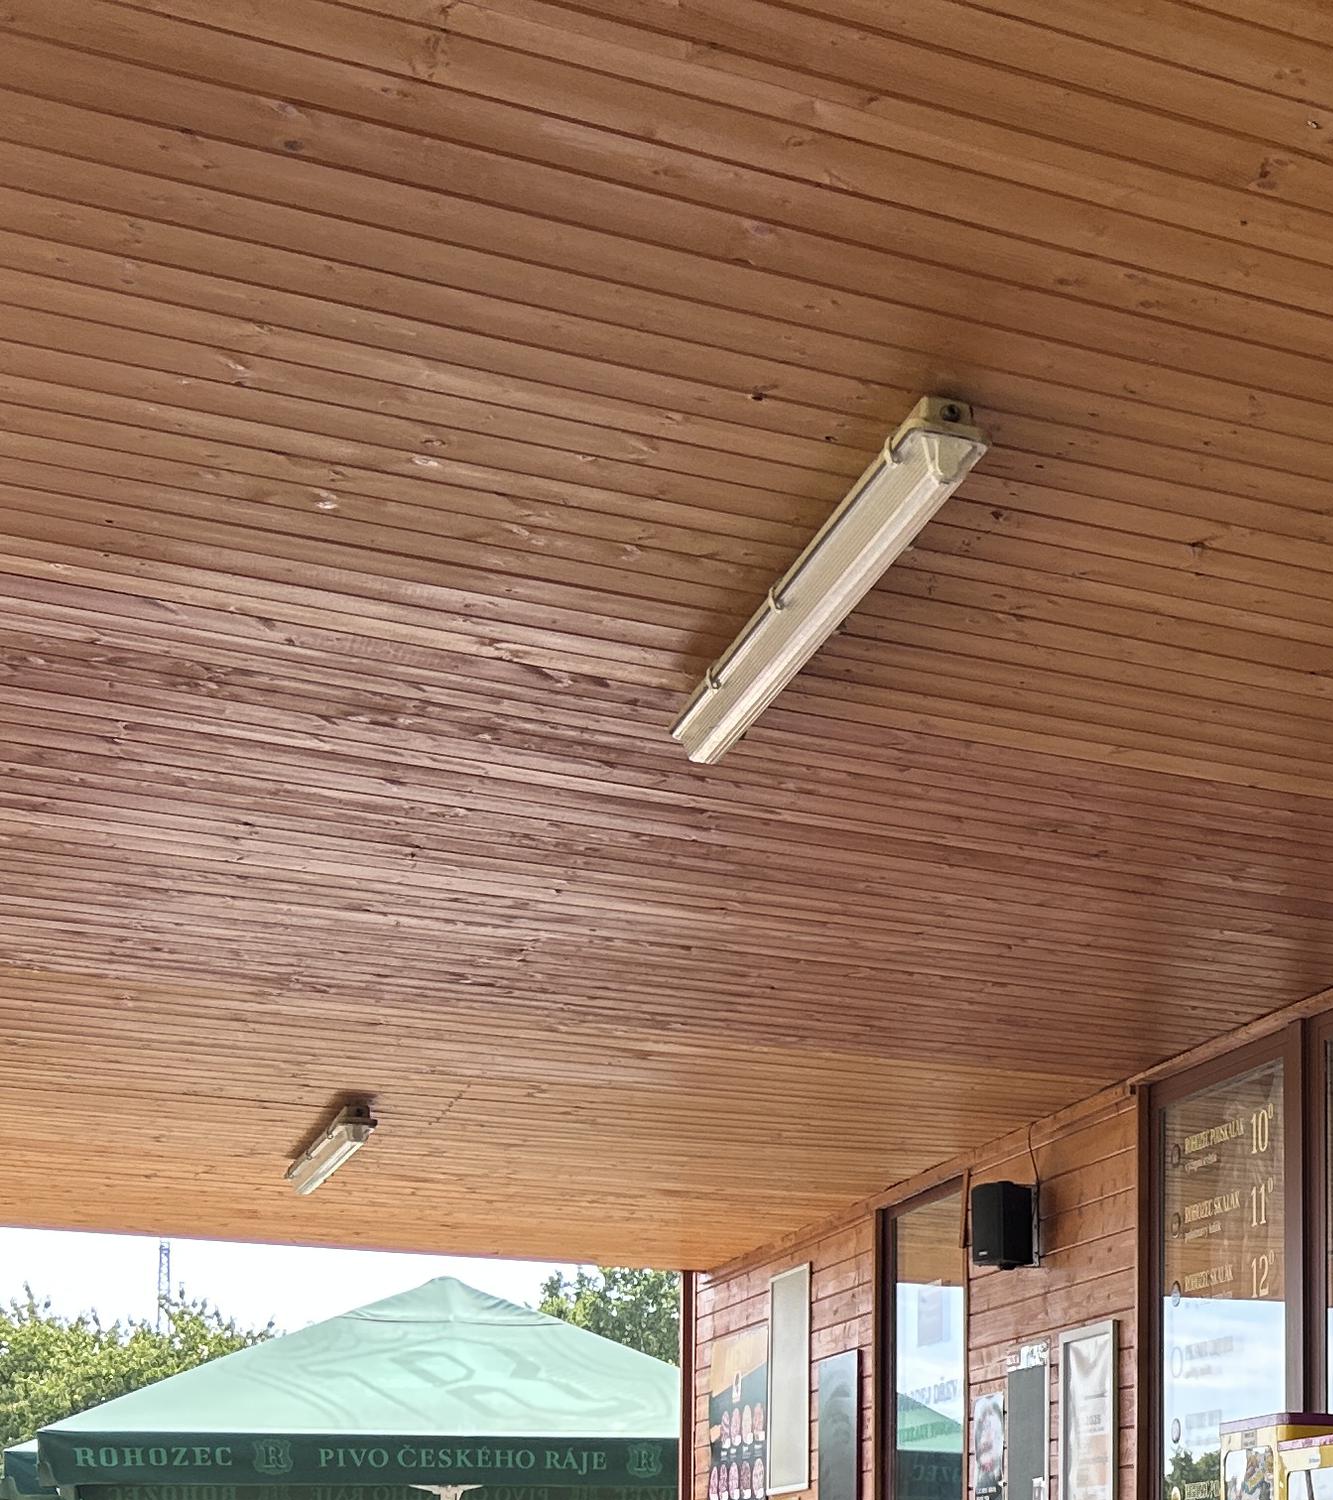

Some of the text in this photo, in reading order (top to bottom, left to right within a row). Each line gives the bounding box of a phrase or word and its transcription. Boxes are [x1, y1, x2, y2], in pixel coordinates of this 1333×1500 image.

[74, 1446, 233, 1468] ROHOZEC
[319, 1448, 389, 1468] PIVO
[397, 1443, 536, 1470] ČESKÉHO
[544, 1447, 608, 1474] RÁJE
